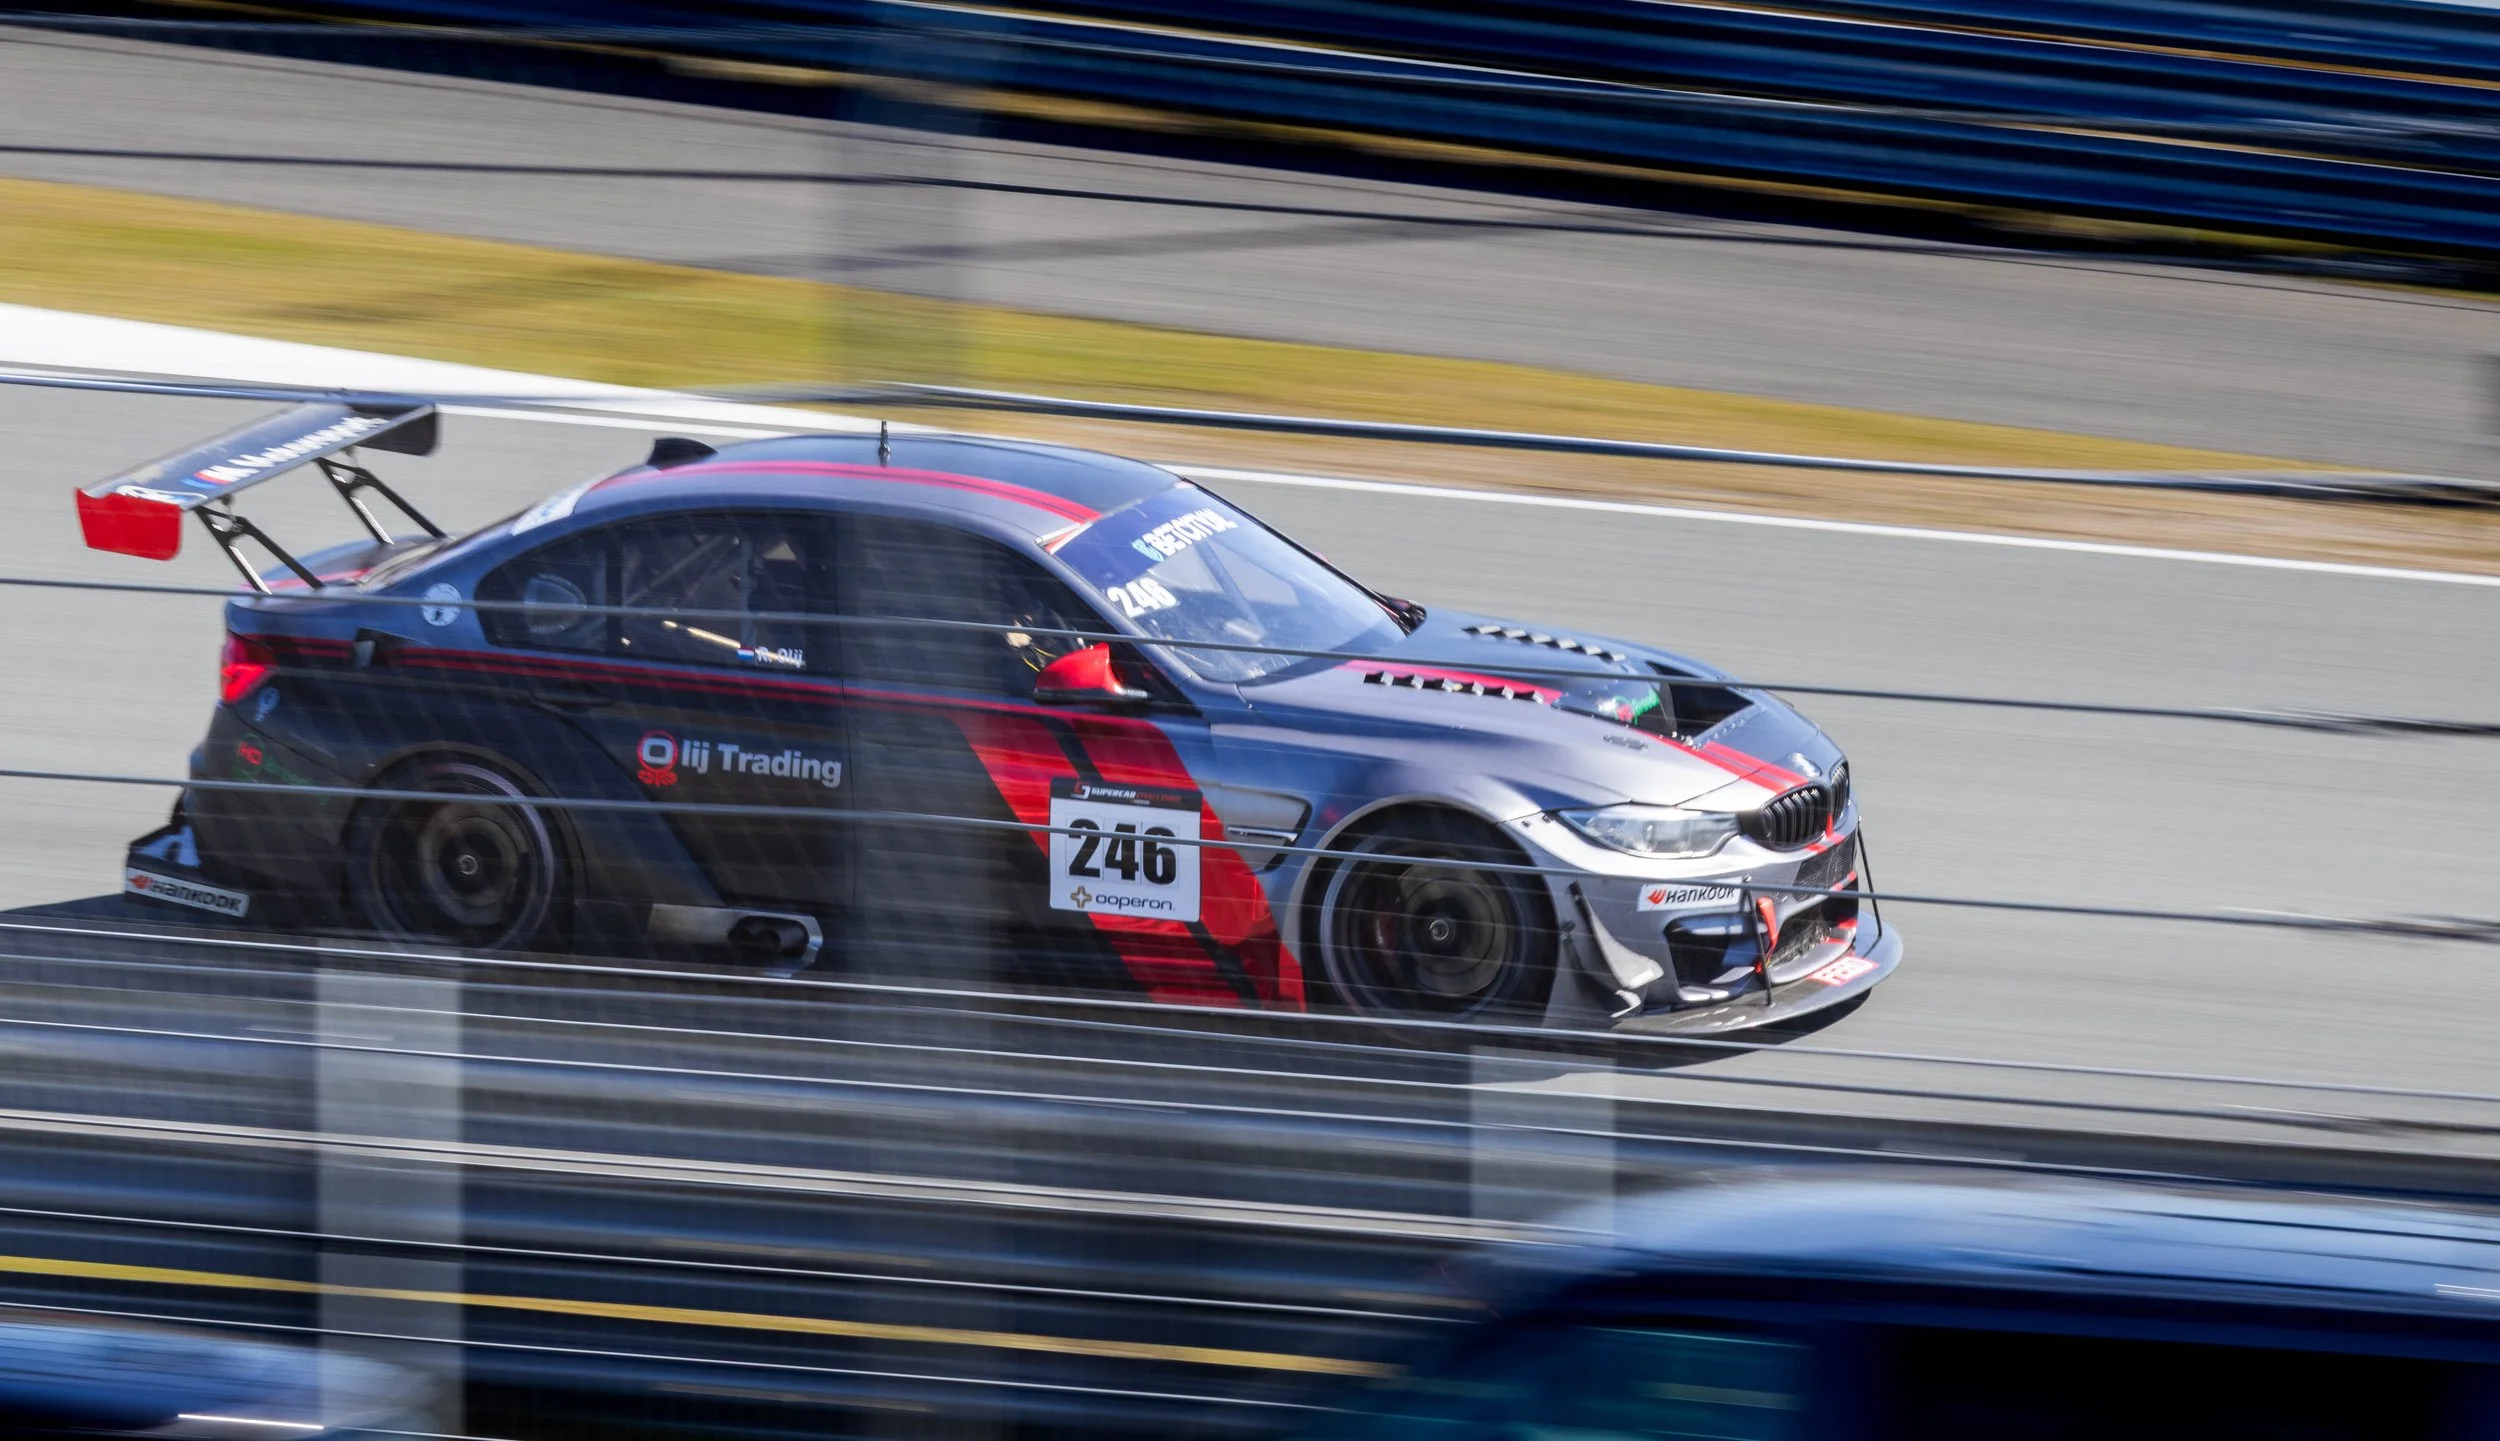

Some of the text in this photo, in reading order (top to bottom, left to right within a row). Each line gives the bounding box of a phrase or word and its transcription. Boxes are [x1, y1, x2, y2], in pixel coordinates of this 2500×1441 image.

[1106, 576, 1177, 618] 246
[717, 742, 842, 788] Trading
[1091, 787, 1137, 799] SUPERCAR
[1068, 818, 1177, 886] 246
